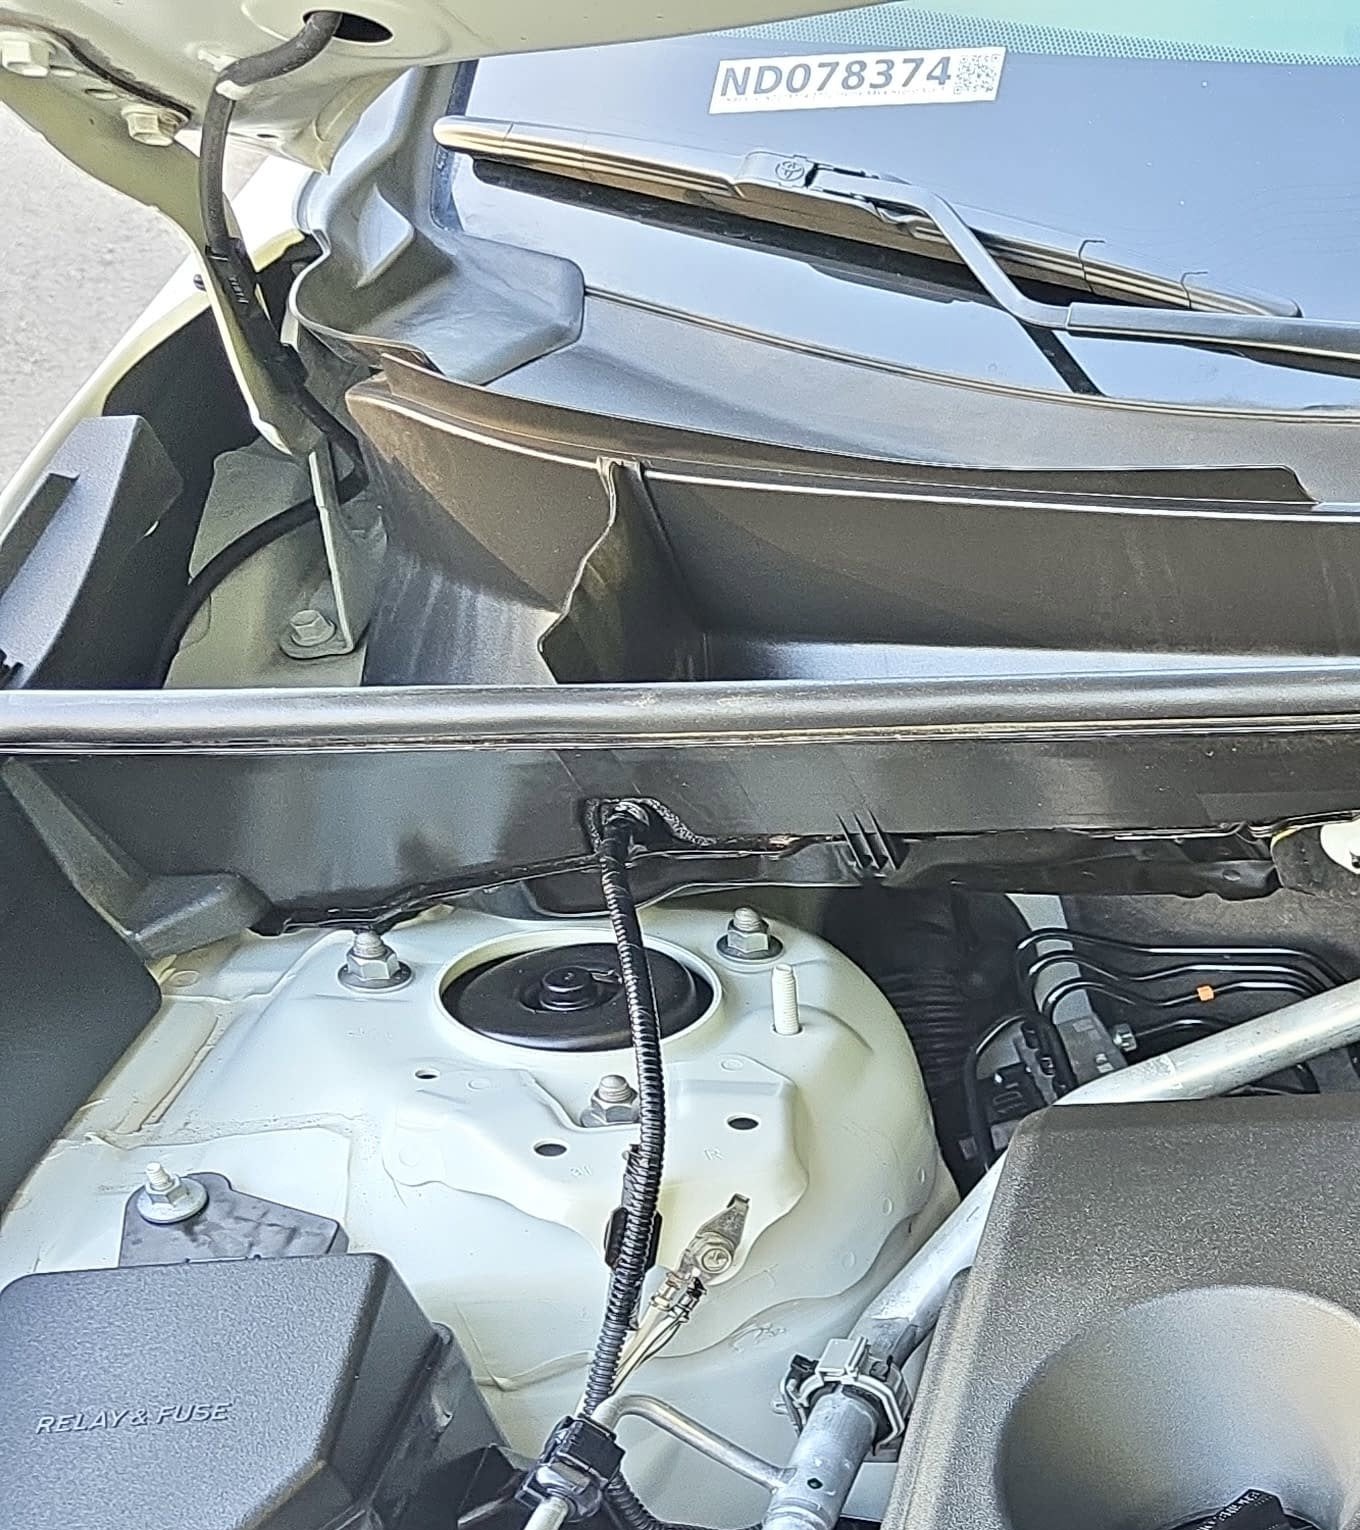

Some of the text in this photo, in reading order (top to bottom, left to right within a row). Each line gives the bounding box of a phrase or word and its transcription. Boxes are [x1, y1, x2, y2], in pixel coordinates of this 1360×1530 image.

[720, 56, 952, 96] ND078374
[36, 1408, 134, 1435] RELAY
[155, 1401, 233, 1424] FUSE
